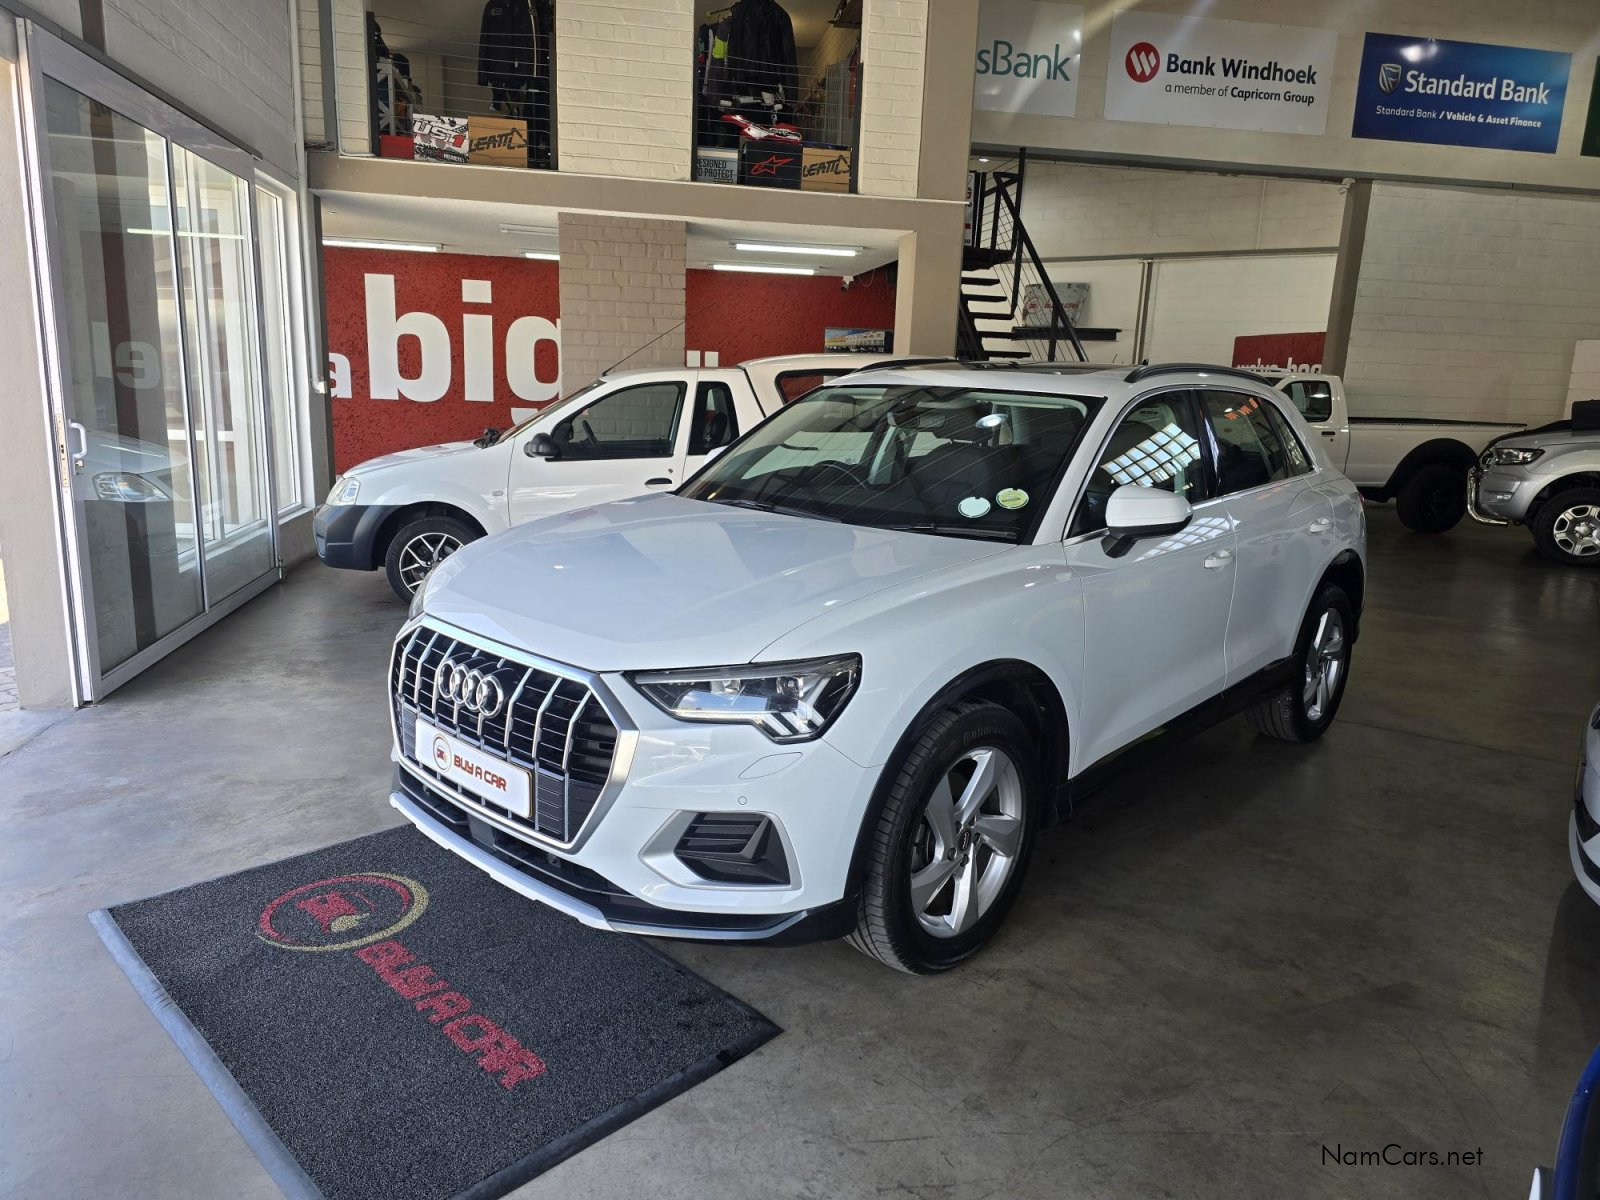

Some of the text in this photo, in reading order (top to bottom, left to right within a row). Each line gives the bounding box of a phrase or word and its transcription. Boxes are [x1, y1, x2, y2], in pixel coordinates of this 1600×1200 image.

[1166, 53, 1318, 85] Bank Windhoek
[1165, 84, 1315, 106] a member of Capricorn Group
[1404, 69, 1551, 105] Standard Bank
[1376, 105, 1415, 117] Standard
[1416, 108, 1437, 119] Bank
[1446, 111, 1476, 123] Vehicle
[1477, 113, 1484, 123] &
[1486, 114, 1508, 125] Asset
[1510, 116, 1542, 128] Finance
[704, 168, 733, 179] PROTECT
[454, 754, 507, 792] BUY A CAR
